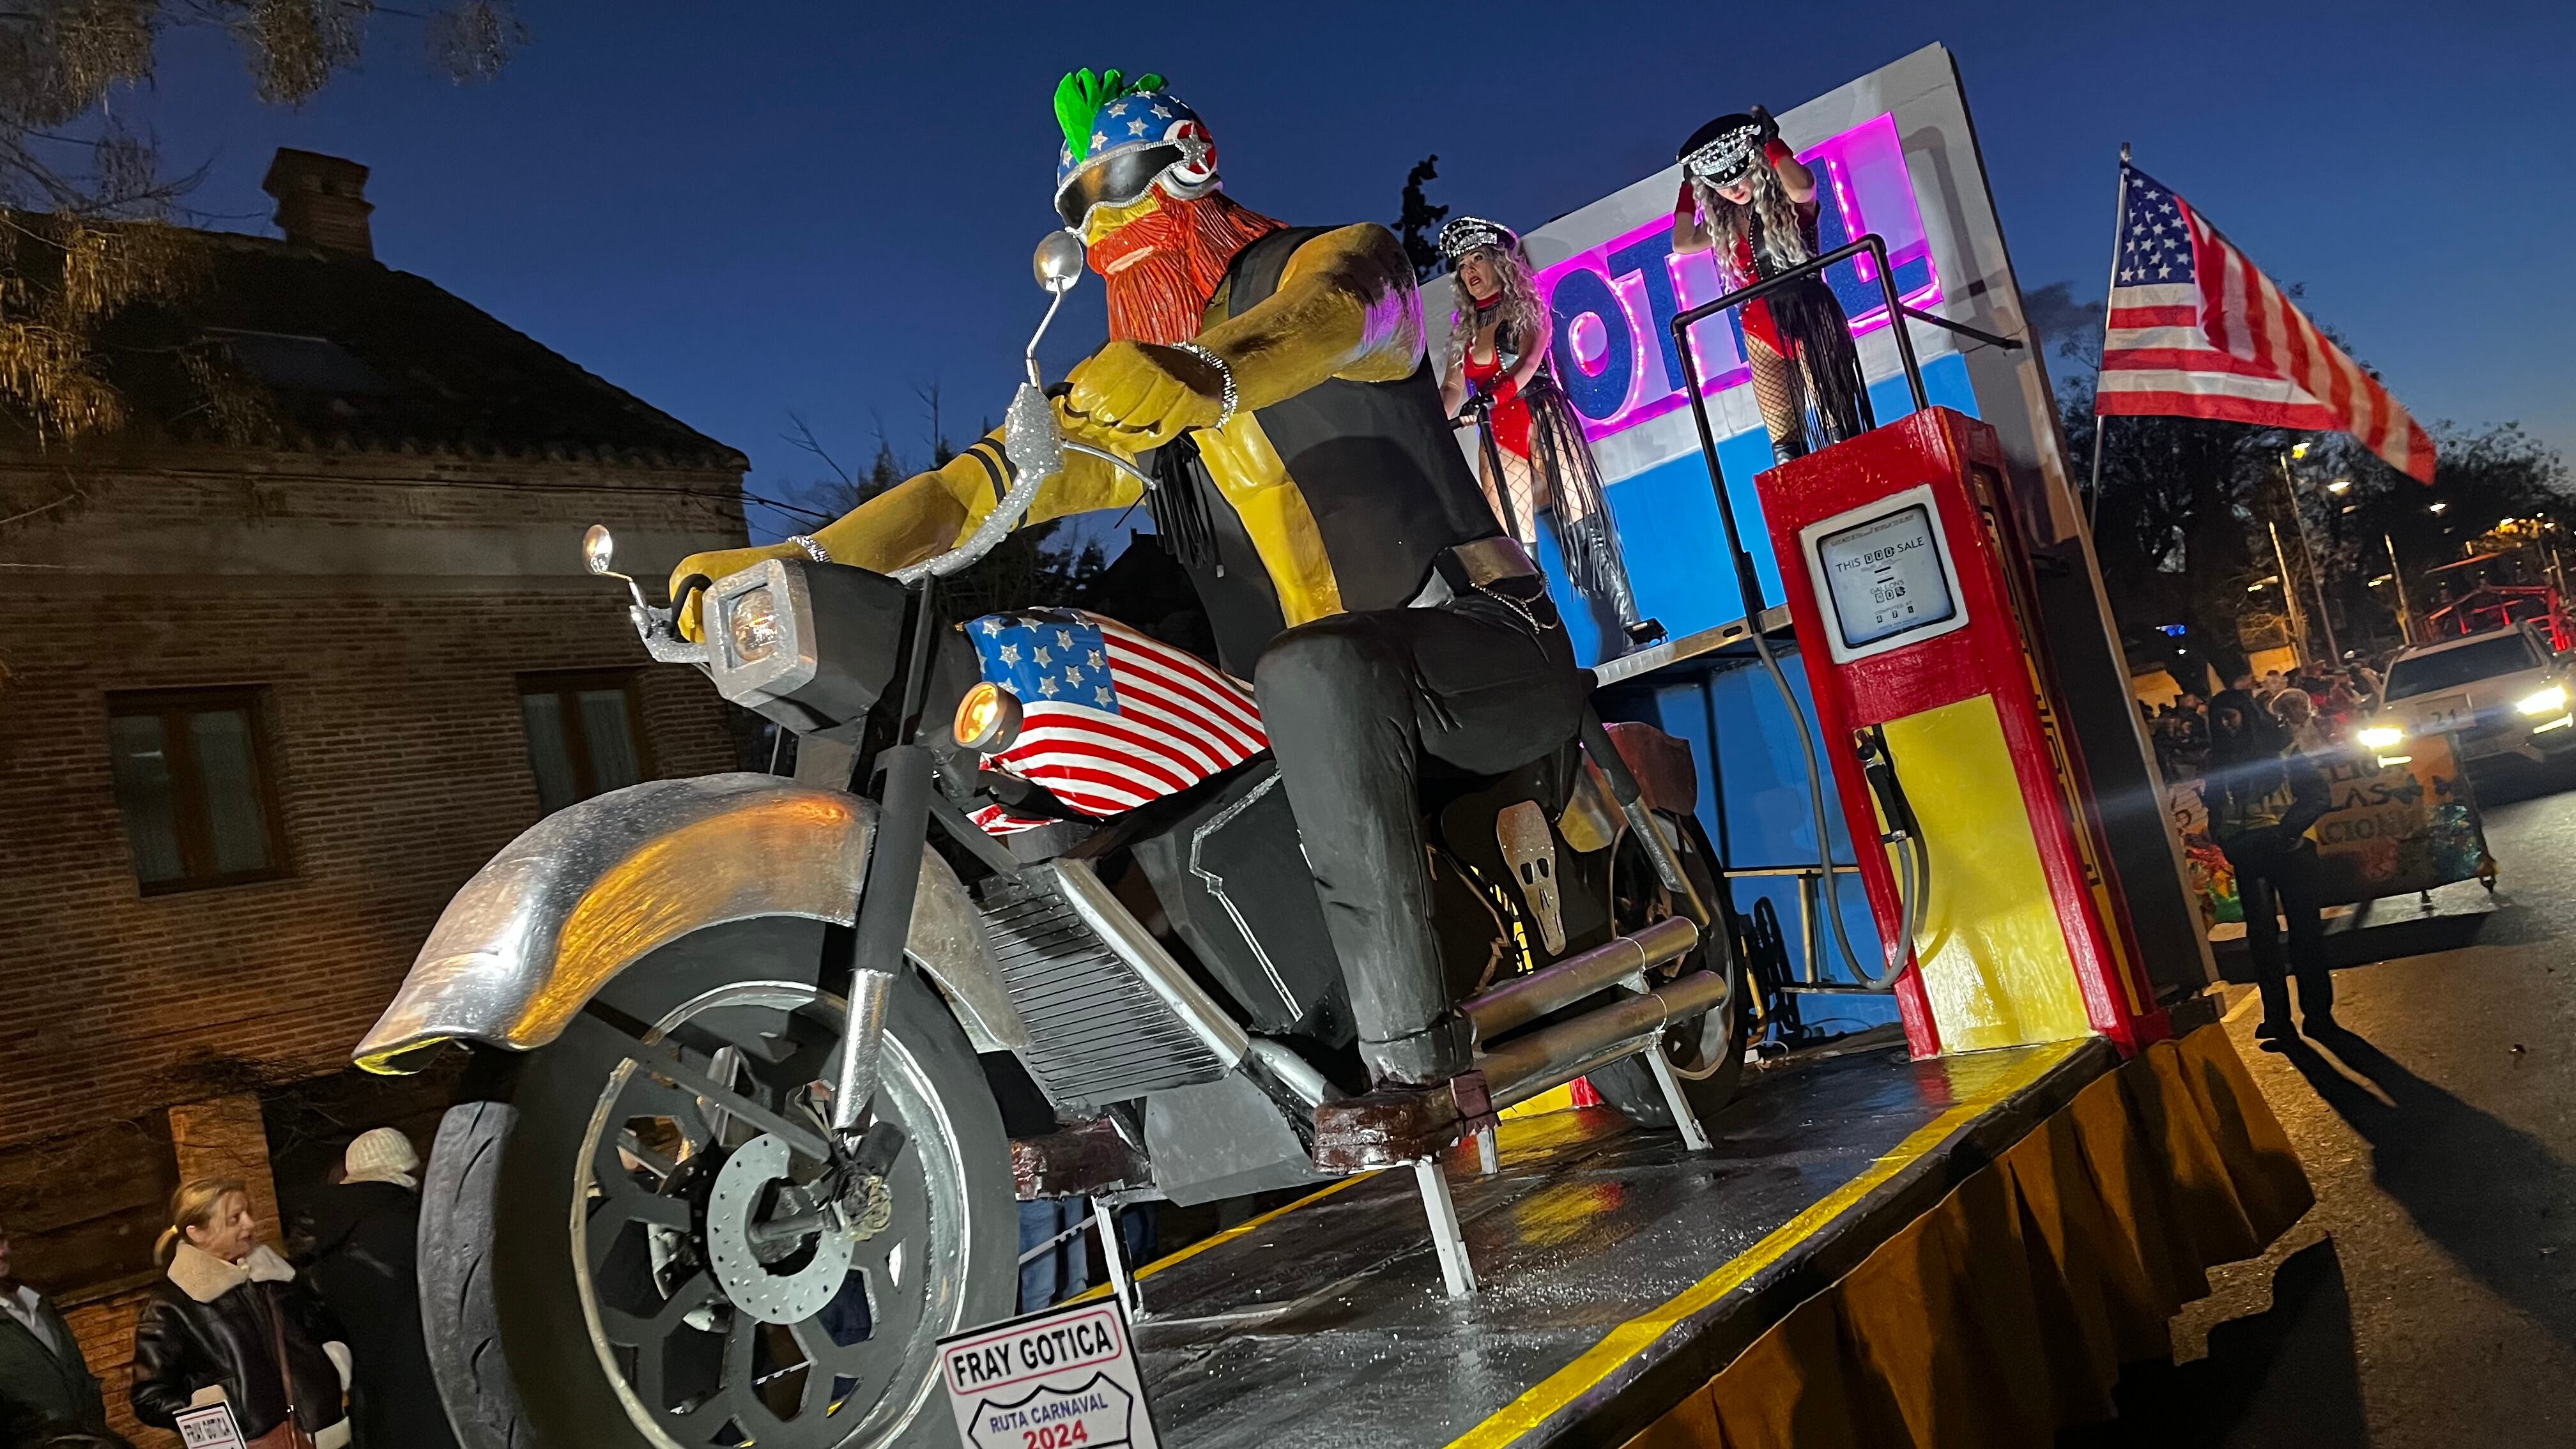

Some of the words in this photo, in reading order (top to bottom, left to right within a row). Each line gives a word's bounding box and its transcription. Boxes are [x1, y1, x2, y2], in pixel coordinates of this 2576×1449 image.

[1835, 558, 1861, 572] THIS
[1897, 536, 1925, 553] SALE
[953, 1342, 1012, 1387] FRAY
[1019, 1320, 1114, 1370] GOTICA
[990, 1410, 1030, 1434] RUTA
[1031, 1392, 1109, 1425] CARNAVAL
[1022, 1419, 1089, 1449] 2024
